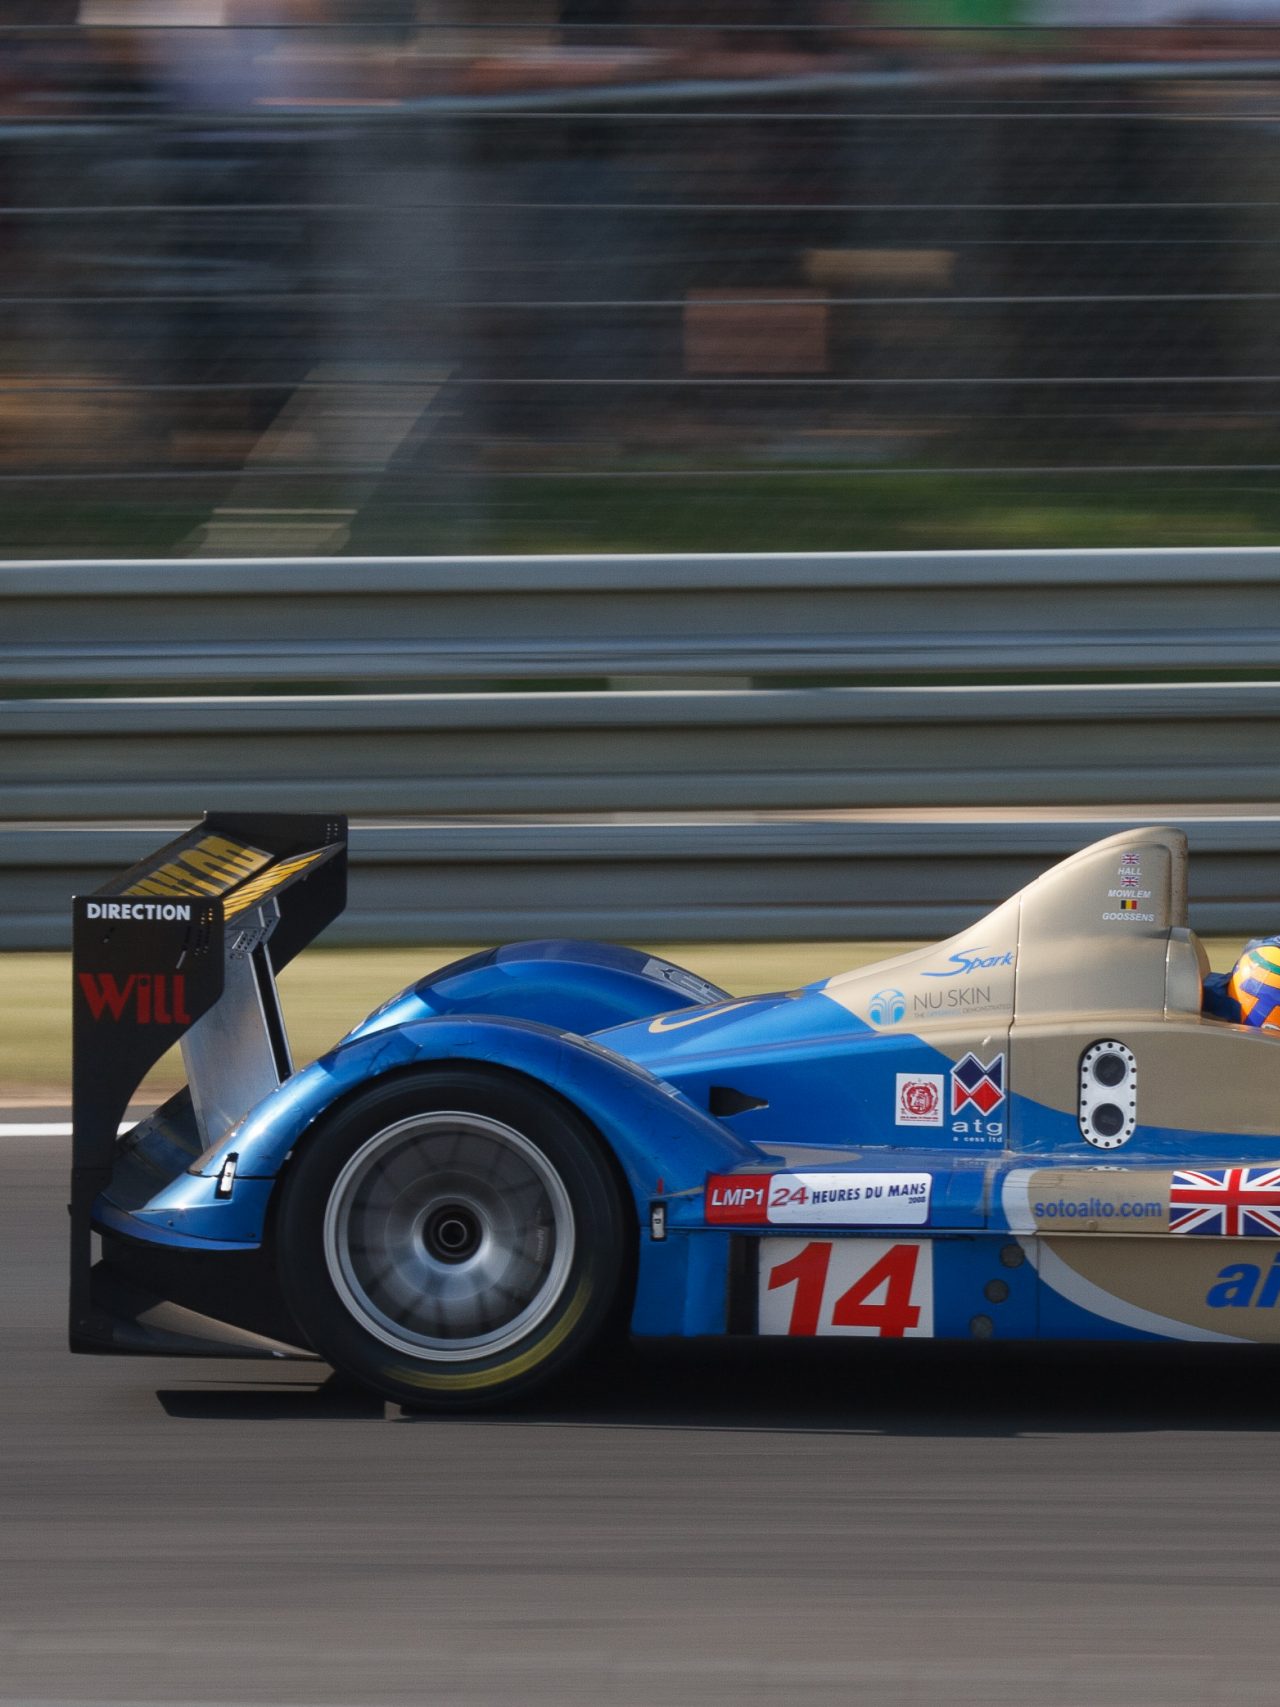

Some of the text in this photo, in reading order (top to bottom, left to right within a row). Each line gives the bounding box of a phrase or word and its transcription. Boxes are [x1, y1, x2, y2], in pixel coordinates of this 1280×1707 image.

[1118, 867, 1142, 875] HALL
[1108, 889, 1151, 898] MOWLEM
[87, 903, 190, 920] DIRECTION
[1102, 912, 1154, 922] GOOSSENS
[920, 945, 1014, 977] Spark
[78, 973, 191, 1025] Will
[914, 986, 990, 1010] NU SKIN
[952, 1119, 1003, 1136] atg
[711, 1188, 763, 1206] LMP1
[770, 1183, 926, 1208] 24 HEURES DU MANS
[767, 1241, 921, 1338] 14
